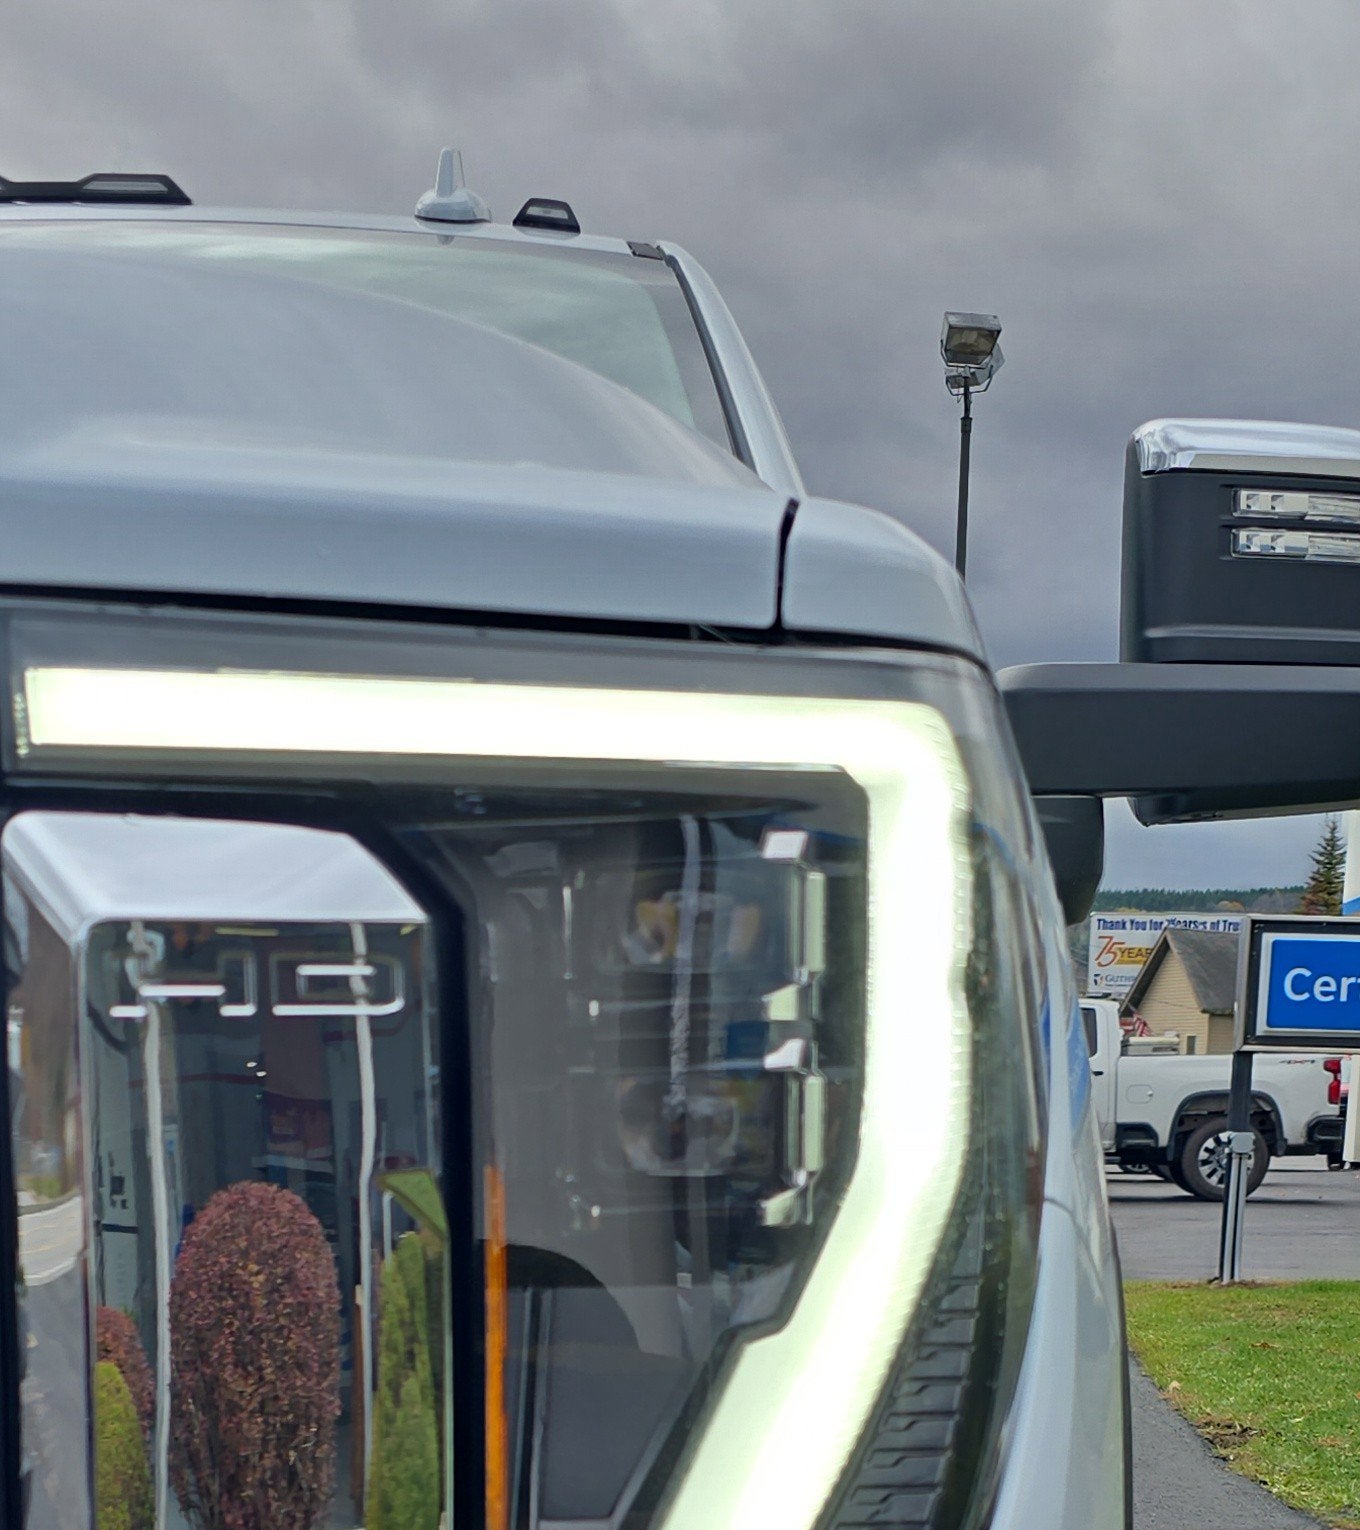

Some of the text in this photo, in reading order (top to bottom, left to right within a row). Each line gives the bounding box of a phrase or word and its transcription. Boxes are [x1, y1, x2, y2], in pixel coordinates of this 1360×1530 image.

[1096, 918, 1127, 931] Thank
[1130, 918, 1147, 931] You
[1149, 918, 1163, 931] for
[1095, 935, 1126, 968] 75
